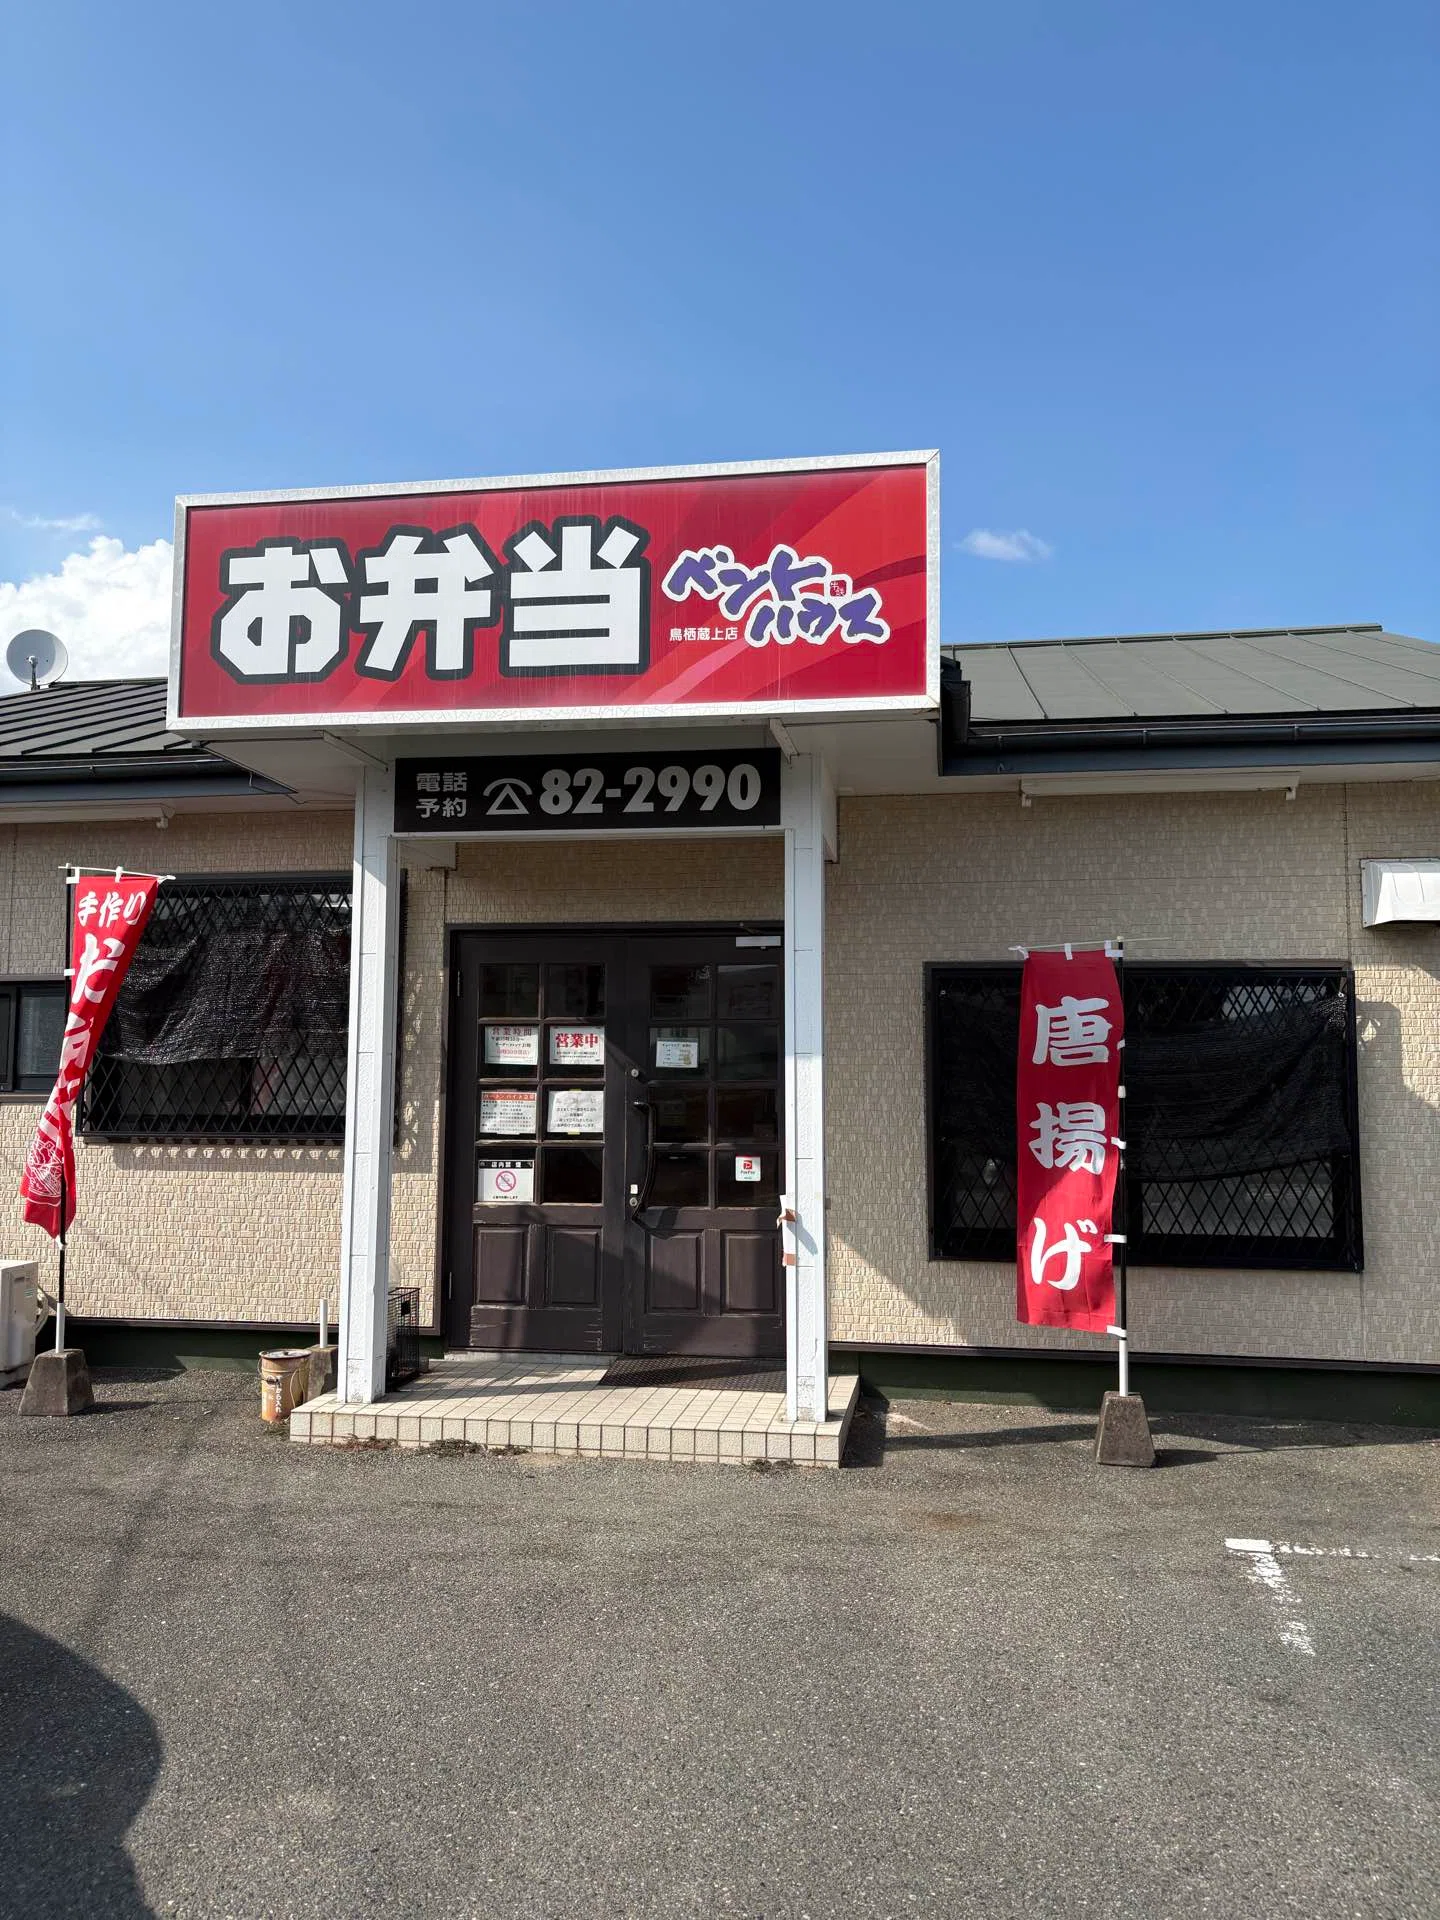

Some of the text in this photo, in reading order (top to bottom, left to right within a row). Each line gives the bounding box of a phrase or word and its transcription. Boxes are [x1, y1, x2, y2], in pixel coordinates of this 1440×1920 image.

[219, 524, 643, 676] お弁当
[669, 626, 739, 642] 鳥栖蔵上店
[415, 771, 468, 793] 電話
[539, 763, 762, 816] 82-2990
[415, 796, 467, 819] 予約
[78, 891, 147, 928] 手作り
[555, 1032, 599, 1048] 営業中
[1028, 996, 1114, 1291] 唐揚げ
